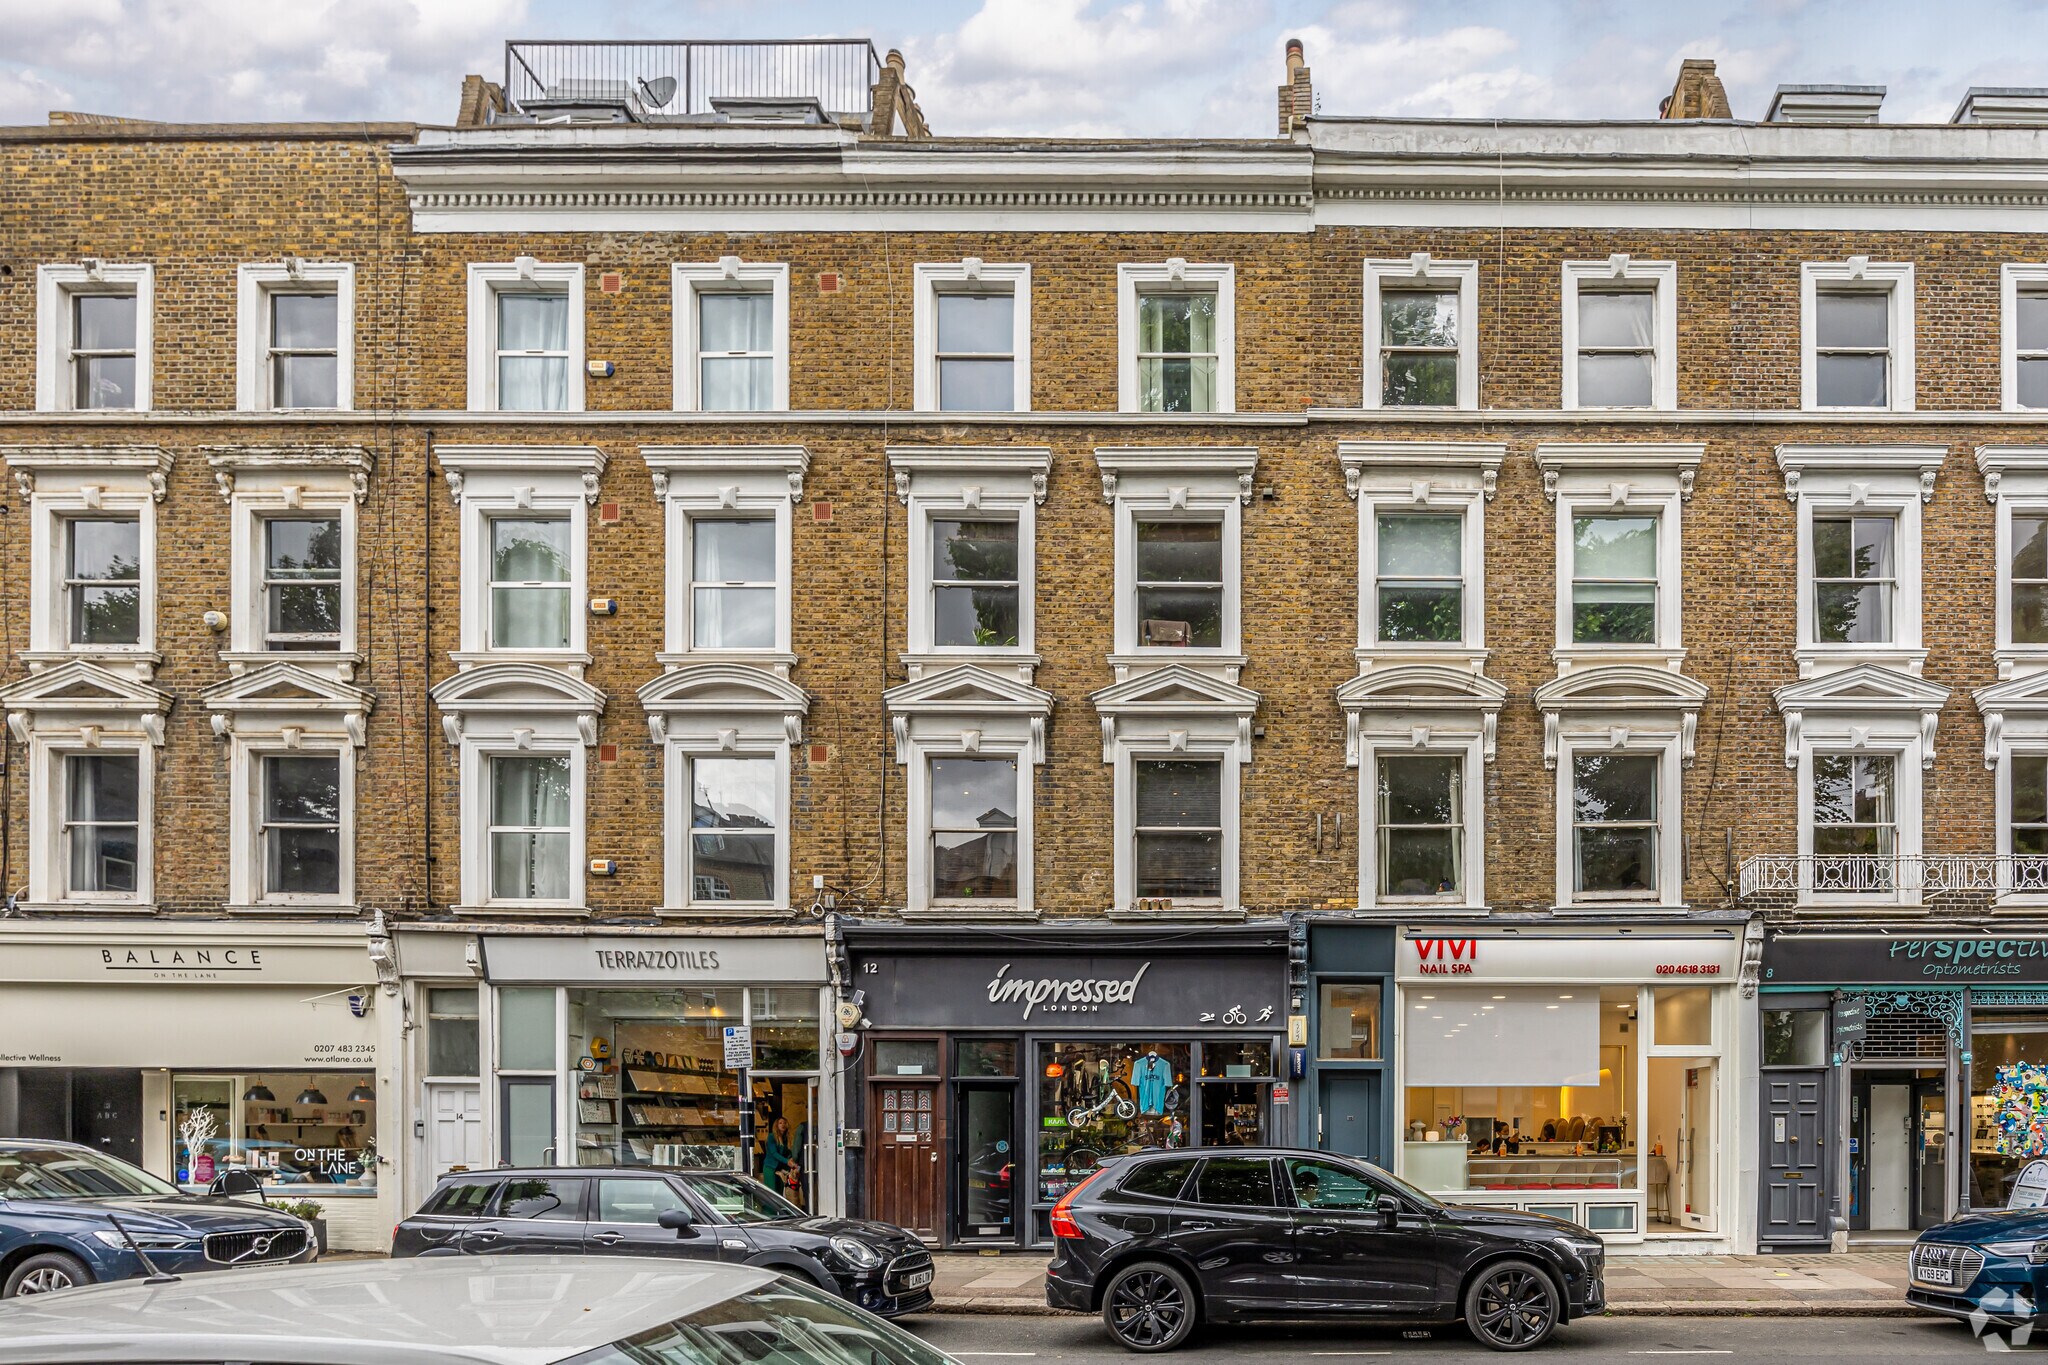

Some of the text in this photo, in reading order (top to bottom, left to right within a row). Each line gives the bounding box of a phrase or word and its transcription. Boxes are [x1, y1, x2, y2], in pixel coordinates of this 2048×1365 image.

[1414, 939, 1477, 960] VIVI
[102, 949, 261, 964] BALANCE
[595, 950, 720, 969] TERRAZZOTILES
[863, 963, 878, 974] 12
[1420, 963, 1473, 974] NAIL SPA
[1656, 964, 1720, 974] 020 4618 3131
[1766, 968, 1773, 978] 8
[1922, 961, 2021, 980] Optometrists
[987, 961, 1151, 1020] impressed
[1043, 1004, 1099, 1012] LONDON
[314, 1045, 376, 1053] 0207 483 2345
[28, 1054, 62, 1062] Wellness
[304, 1055, 373, 1063] www.otlane.co.uk
[920, 1132, 932, 1142] 12
[294, 1149, 346, 1162] ON THE
[320, 1162, 357, 1174] LANE
[1936, 1270, 1949, 1281] EPC
